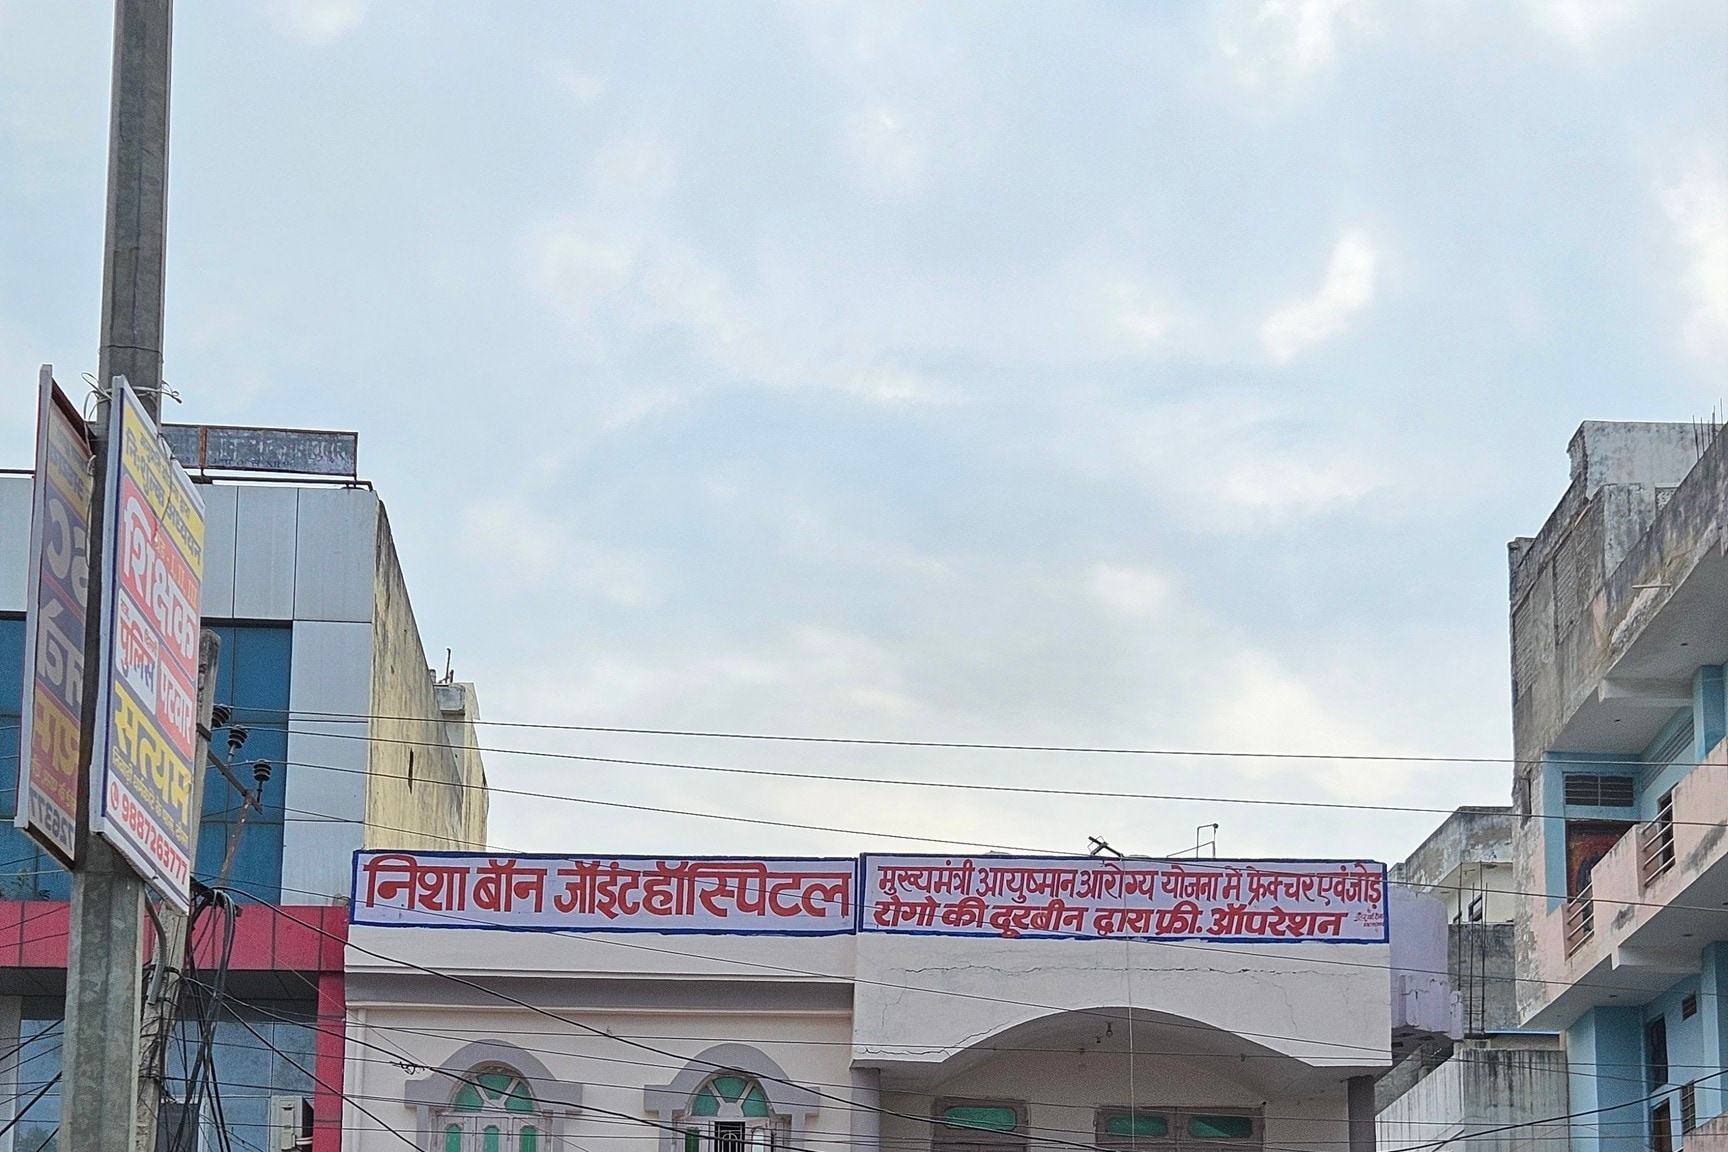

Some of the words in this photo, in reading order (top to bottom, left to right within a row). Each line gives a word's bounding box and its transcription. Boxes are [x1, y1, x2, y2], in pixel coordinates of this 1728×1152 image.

[123, 495, 197, 660] शिक्षक
[120, 619, 156, 694] पुलिस
[160, 660, 193, 745] पटवार
[115, 680, 192, 825] सत्यम
[121, 794, 188, 886] 9887263777
[363, 854, 470, 911] निशा
[475, 858, 548, 913] बॉन
[878, 859, 975, 895] मुख्यमंत्री
[976, 867, 1078, 904] आयुष्मान
[1076, 862, 1158, 901] आरोग्य
[1161, 865, 1223, 902] योजना
[942, 896, 989, 928] की
[990, 898, 1088, 938] दूरबीन
[1093, 907, 1155, 936] द्वारा
[1206, 903, 1348, 937] ऑपरेशन
